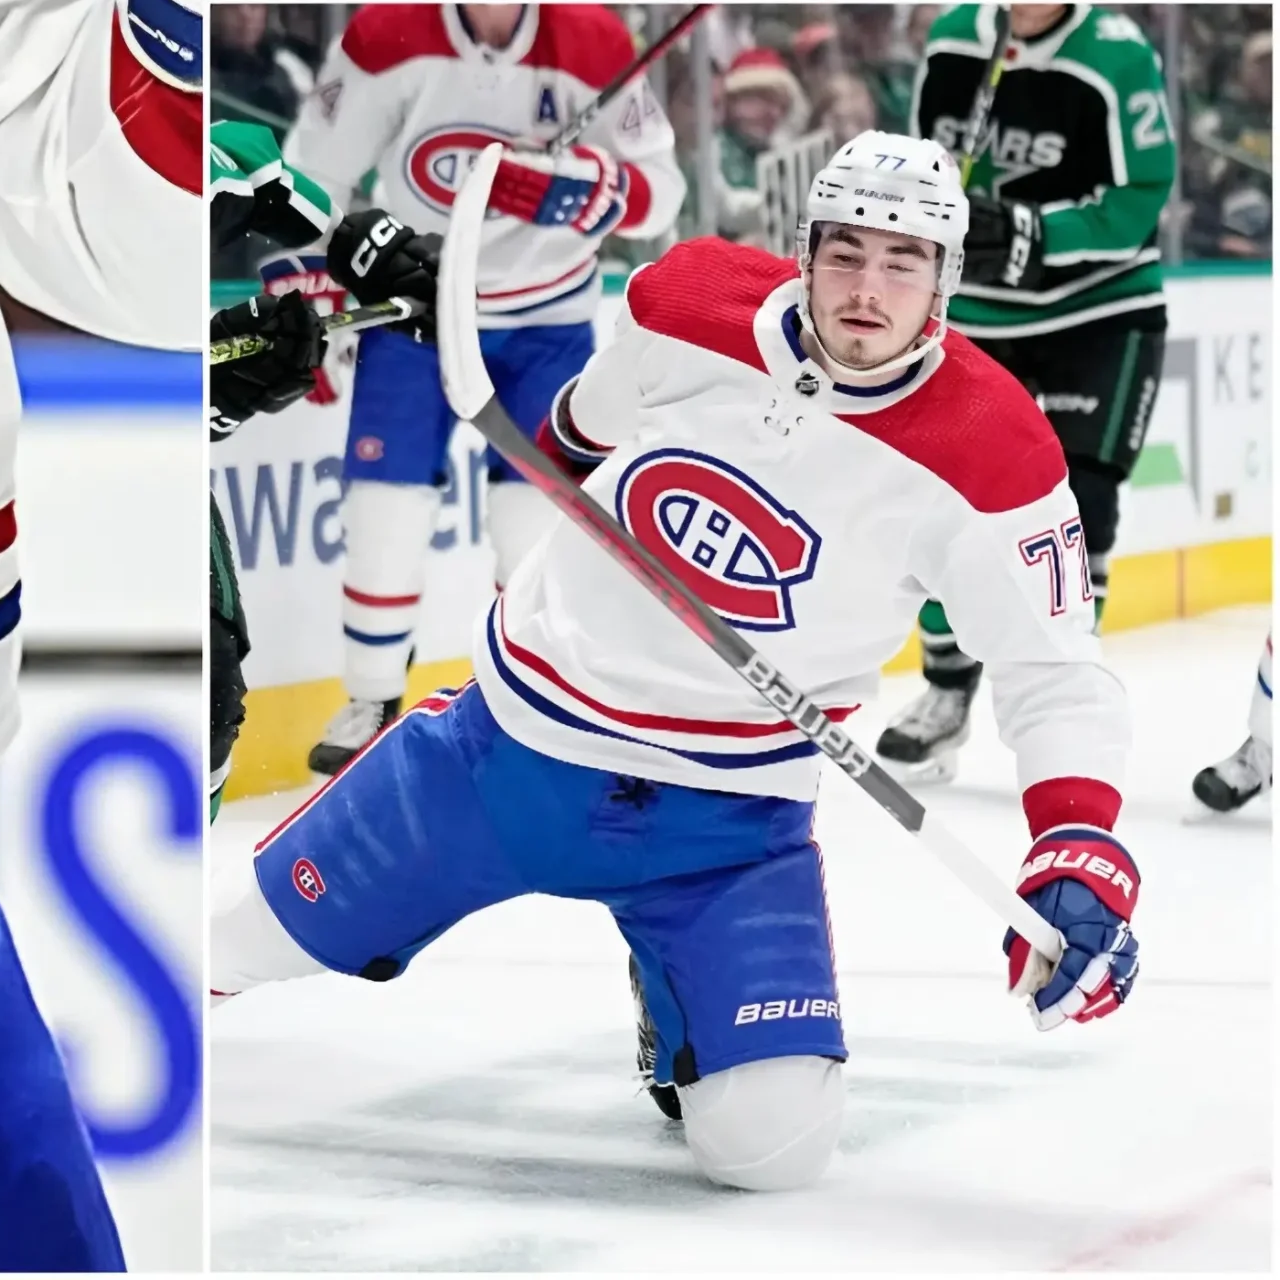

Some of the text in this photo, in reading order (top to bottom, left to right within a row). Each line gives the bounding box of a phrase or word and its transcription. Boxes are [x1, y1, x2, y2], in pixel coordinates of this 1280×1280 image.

[537, 87, 559, 123] A
[1127, 89, 1176, 151] 2
[874, 154, 907, 171] 77
[1018, 516, 1094, 617] 77
